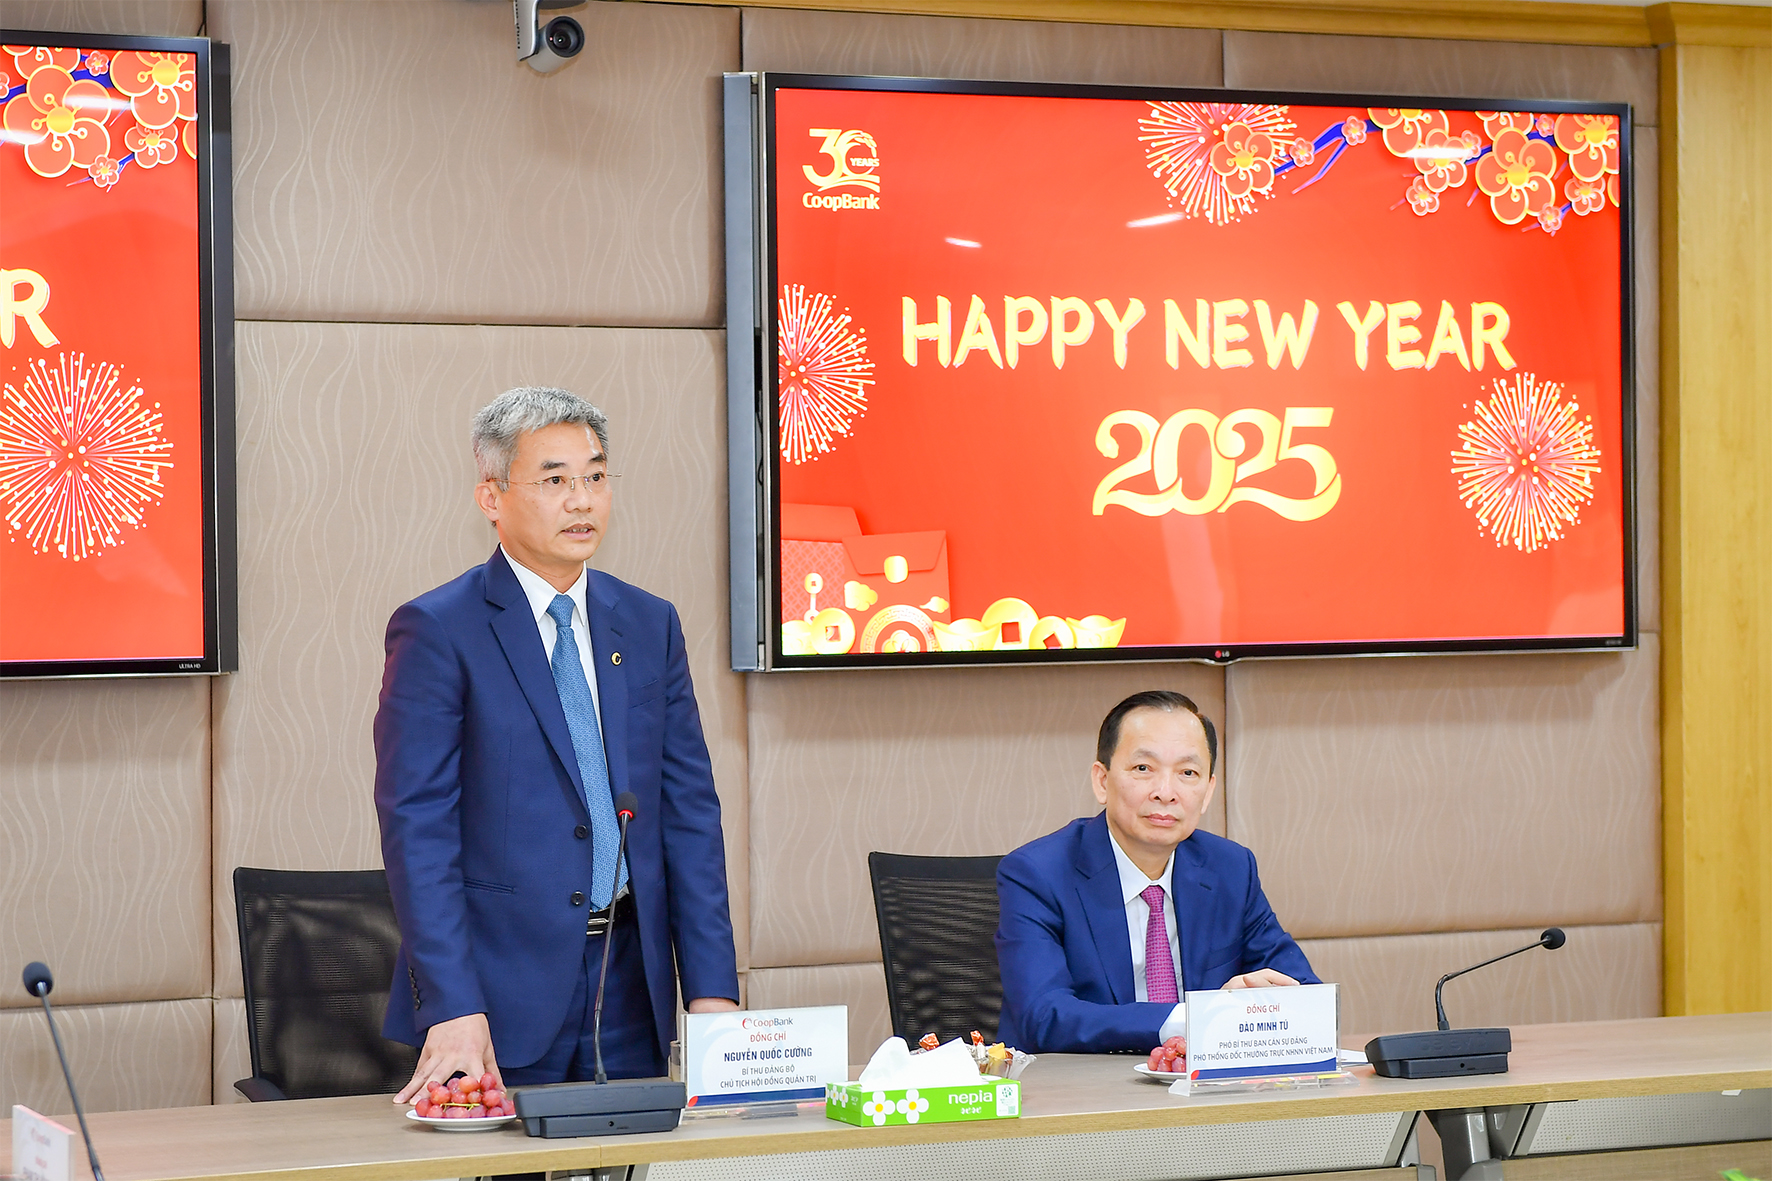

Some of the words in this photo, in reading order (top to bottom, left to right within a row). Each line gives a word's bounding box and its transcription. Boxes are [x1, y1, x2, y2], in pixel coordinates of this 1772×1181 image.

[850, 158, 880, 167] YEARS
[902, 294, 1146, 370] HAPPY
[1163, 298, 1319, 371] NEW
[1336, 299, 1518, 372] YEAR
[1092, 406, 1342, 523] 2025
[1268, 1002, 1280, 1013] CHÍ
[1239, 1020, 1255, 1033] ĐÀO
[1257, 1021, 1277, 1032] MINH
[773, 1030, 787, 1041] CHÍ
[724, 1047, 757, 1062] NGUYỄN
[760, 1046, 782, 1061] QUỐC
[784, 1045, 813, 1059] CƯỜNG
[1318, 1046, 1333, 1054] NAM
[742, 1066, 749, 1075] BÍ
[750, 1066, 764, 1075] THƯ
[764, 1064, 784, 1075] ĐẢNG
[785, 1063, 795, 1074] BỘ
[720, 1079, 734, 1088] CHỦ
[735, 1079, 750, 1089] TỊCH
[751, 1077, 763, 1087] HỘI
[785, 1074, 805, 1085] QUẢN
[806, 1075, 817, 1083] TRỊ
[948, 1089, 993, 1105] nepia
